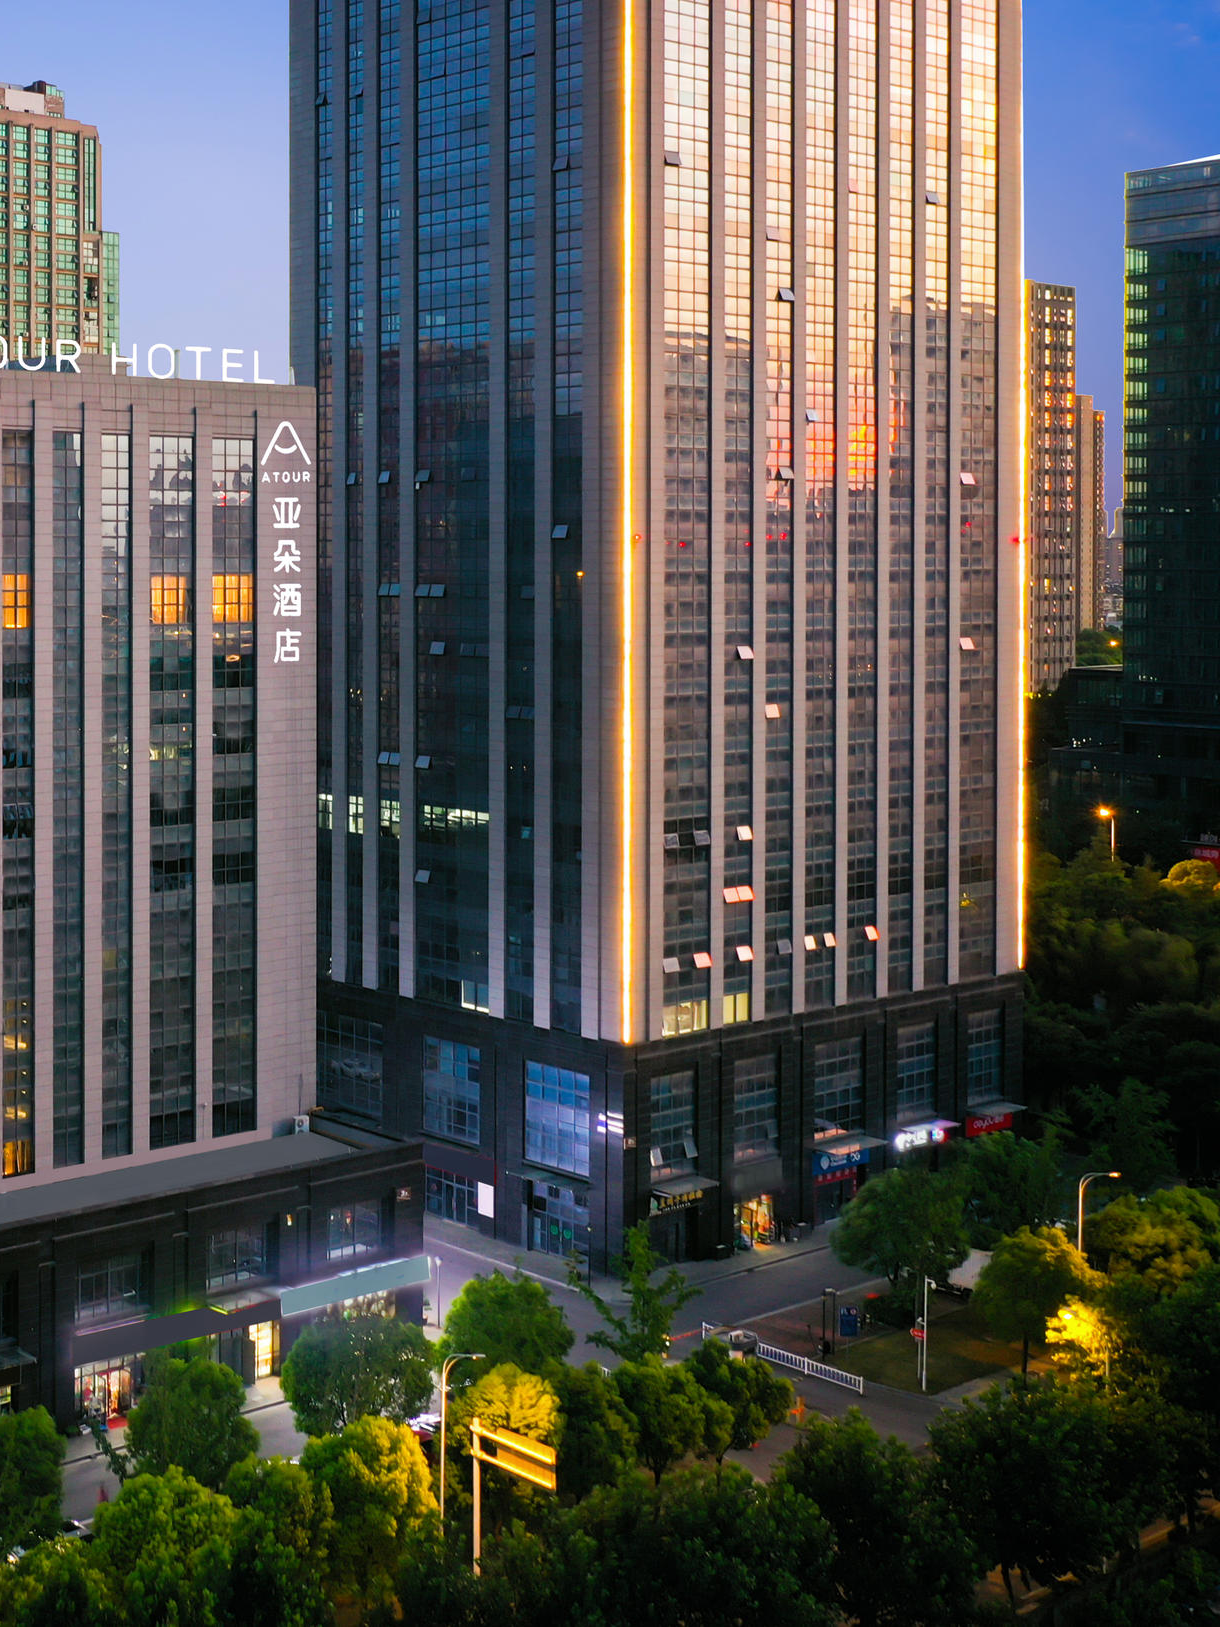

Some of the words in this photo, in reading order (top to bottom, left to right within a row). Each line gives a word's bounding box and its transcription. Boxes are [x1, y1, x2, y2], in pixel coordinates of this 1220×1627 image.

[111, 342, 276, 384] HOTEL
[261, 471, 311, 483] ATOUR
[272, 497, 302, 664] 亚朵酒店
